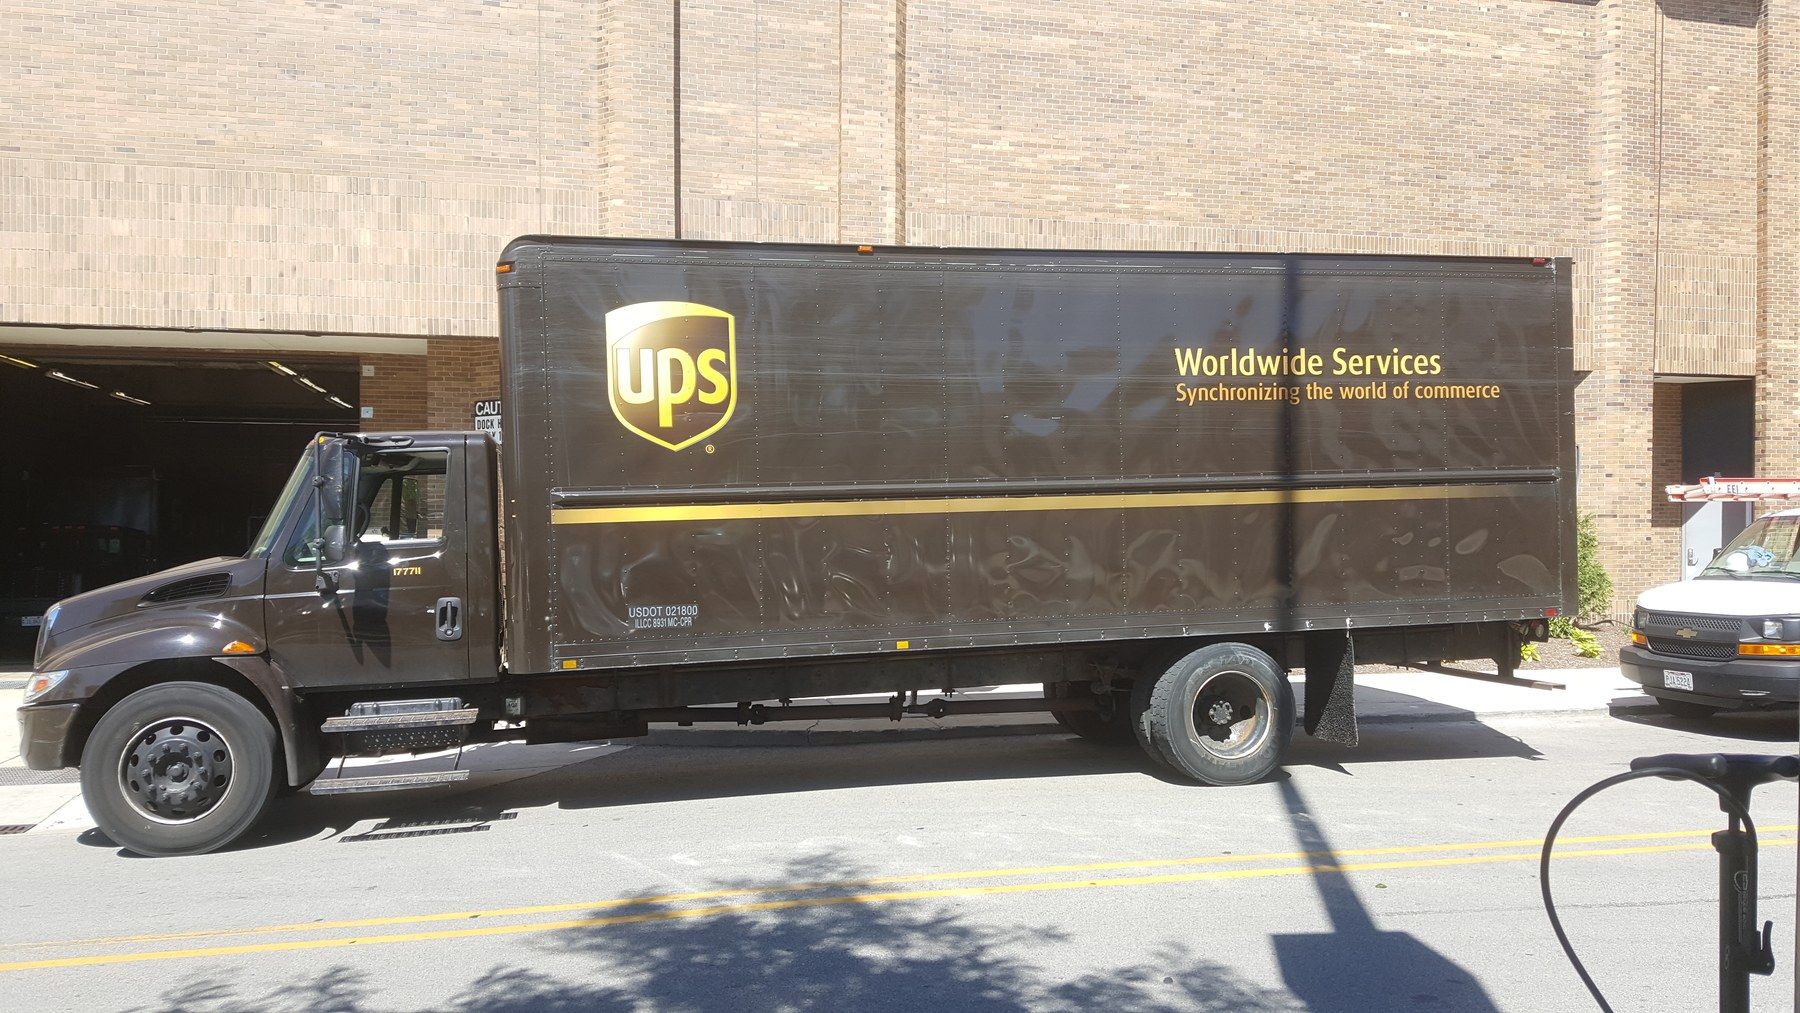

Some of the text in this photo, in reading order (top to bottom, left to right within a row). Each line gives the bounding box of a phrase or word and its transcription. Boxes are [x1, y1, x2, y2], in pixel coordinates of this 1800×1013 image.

[1175, 347, 1441, 376] Worldwide Services
[1176, 381, 1500, 406] Synchronizing the world of commerce
[477, 419, 495, 430] DOCK
[629, 605, 698, 618] USDOT 021800
